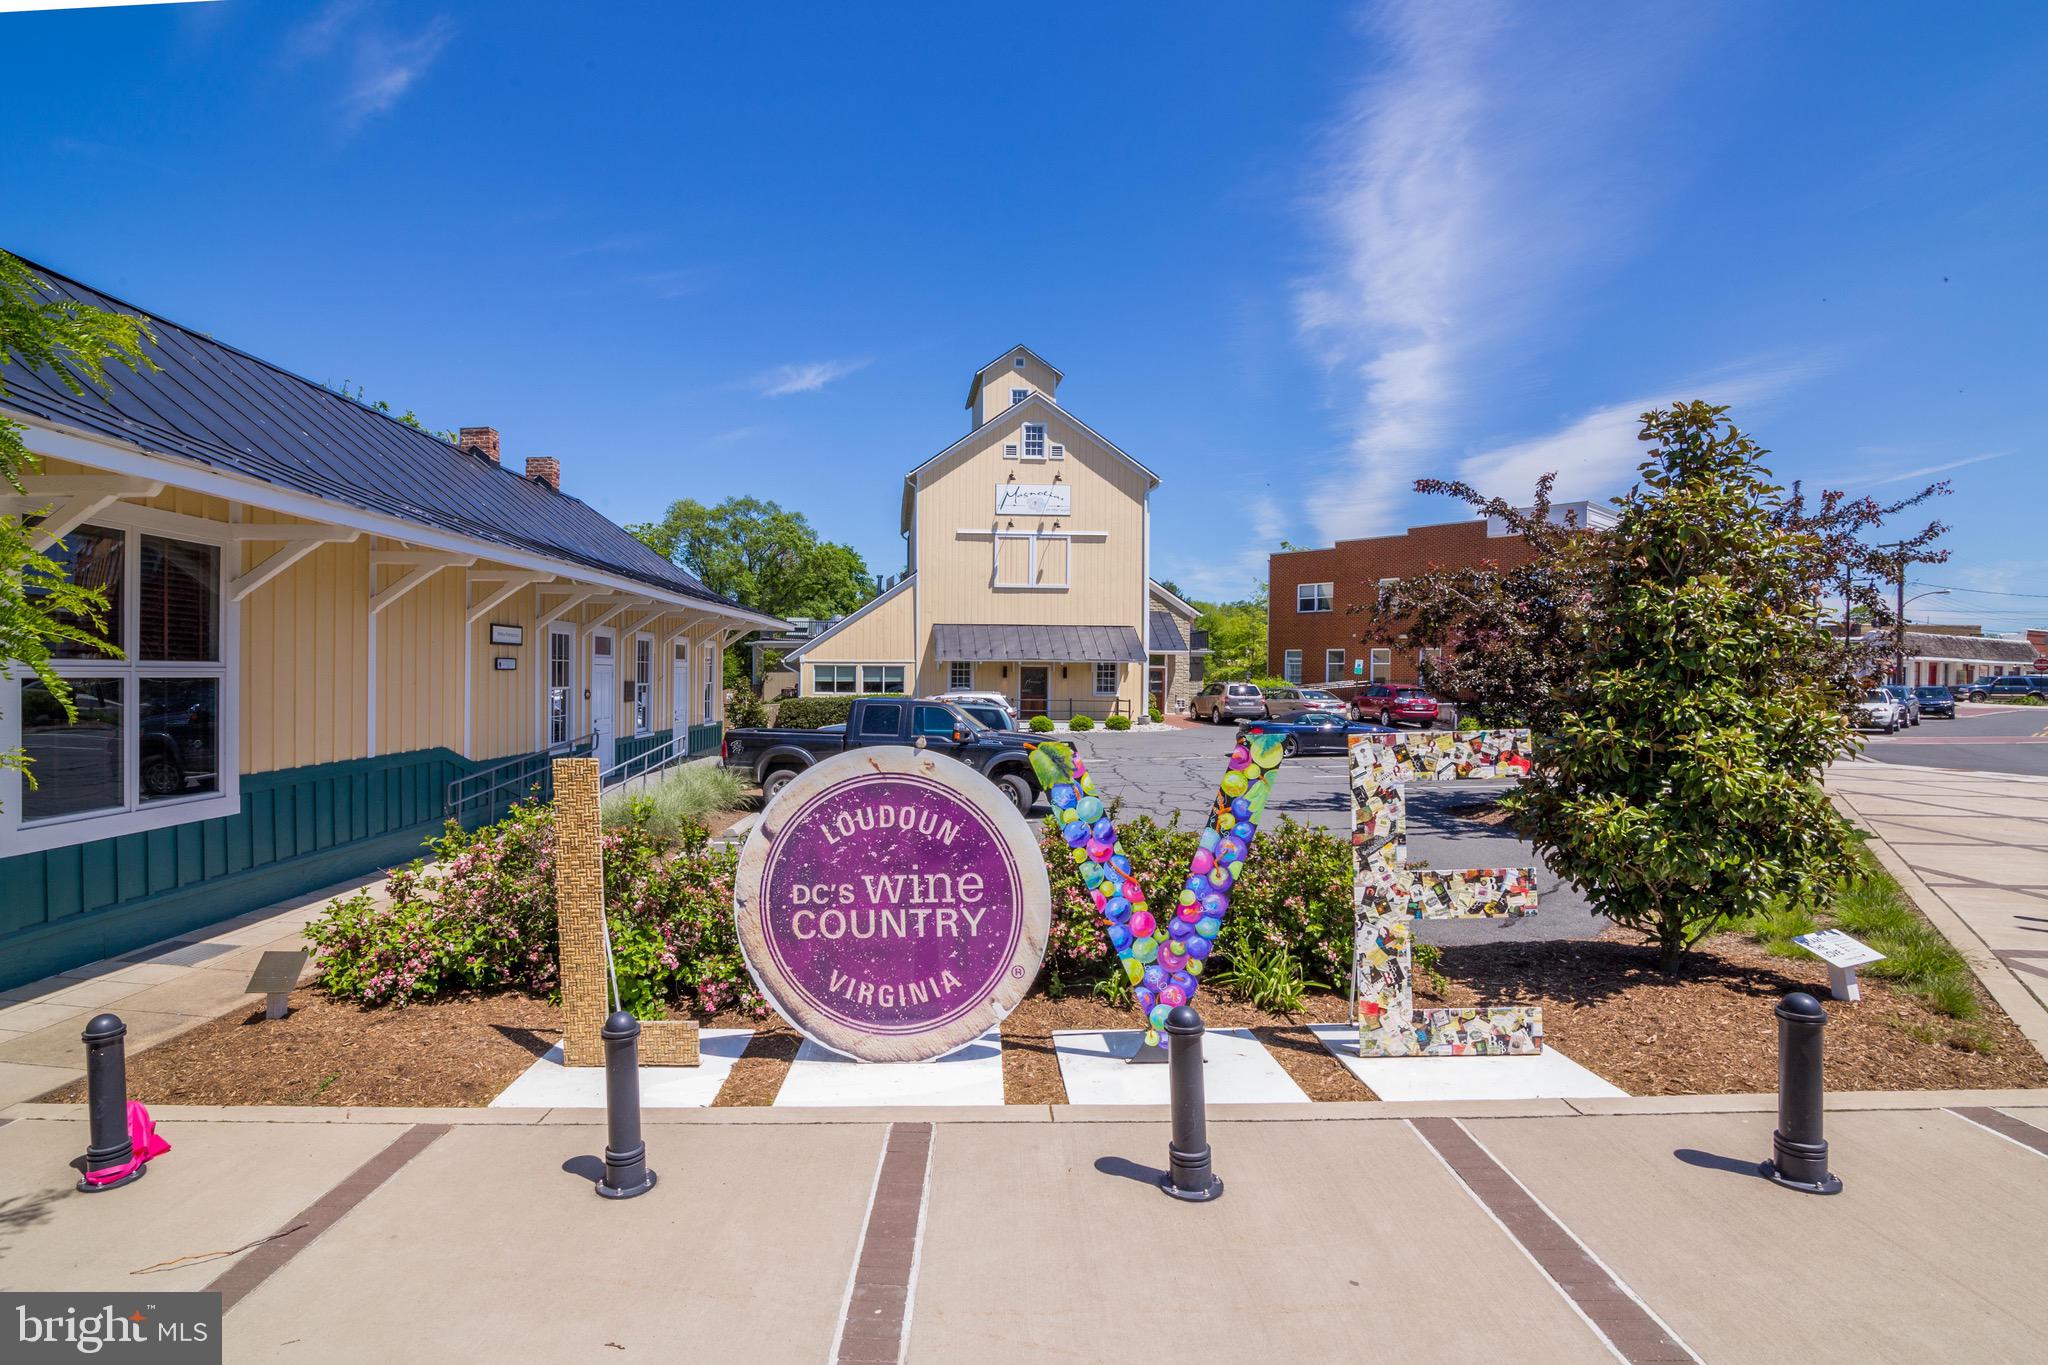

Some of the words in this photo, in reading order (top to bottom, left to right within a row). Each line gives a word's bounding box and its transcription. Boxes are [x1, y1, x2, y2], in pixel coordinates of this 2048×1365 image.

[820, 804, 961, 846] LOUDOUN
[791, 883, 855, 904] DC'S
[861, 864, 985, 904] wine
[791, 907, 987, 939] COUNTRY
[828, 968, 962, 1008] VIRGINIA
